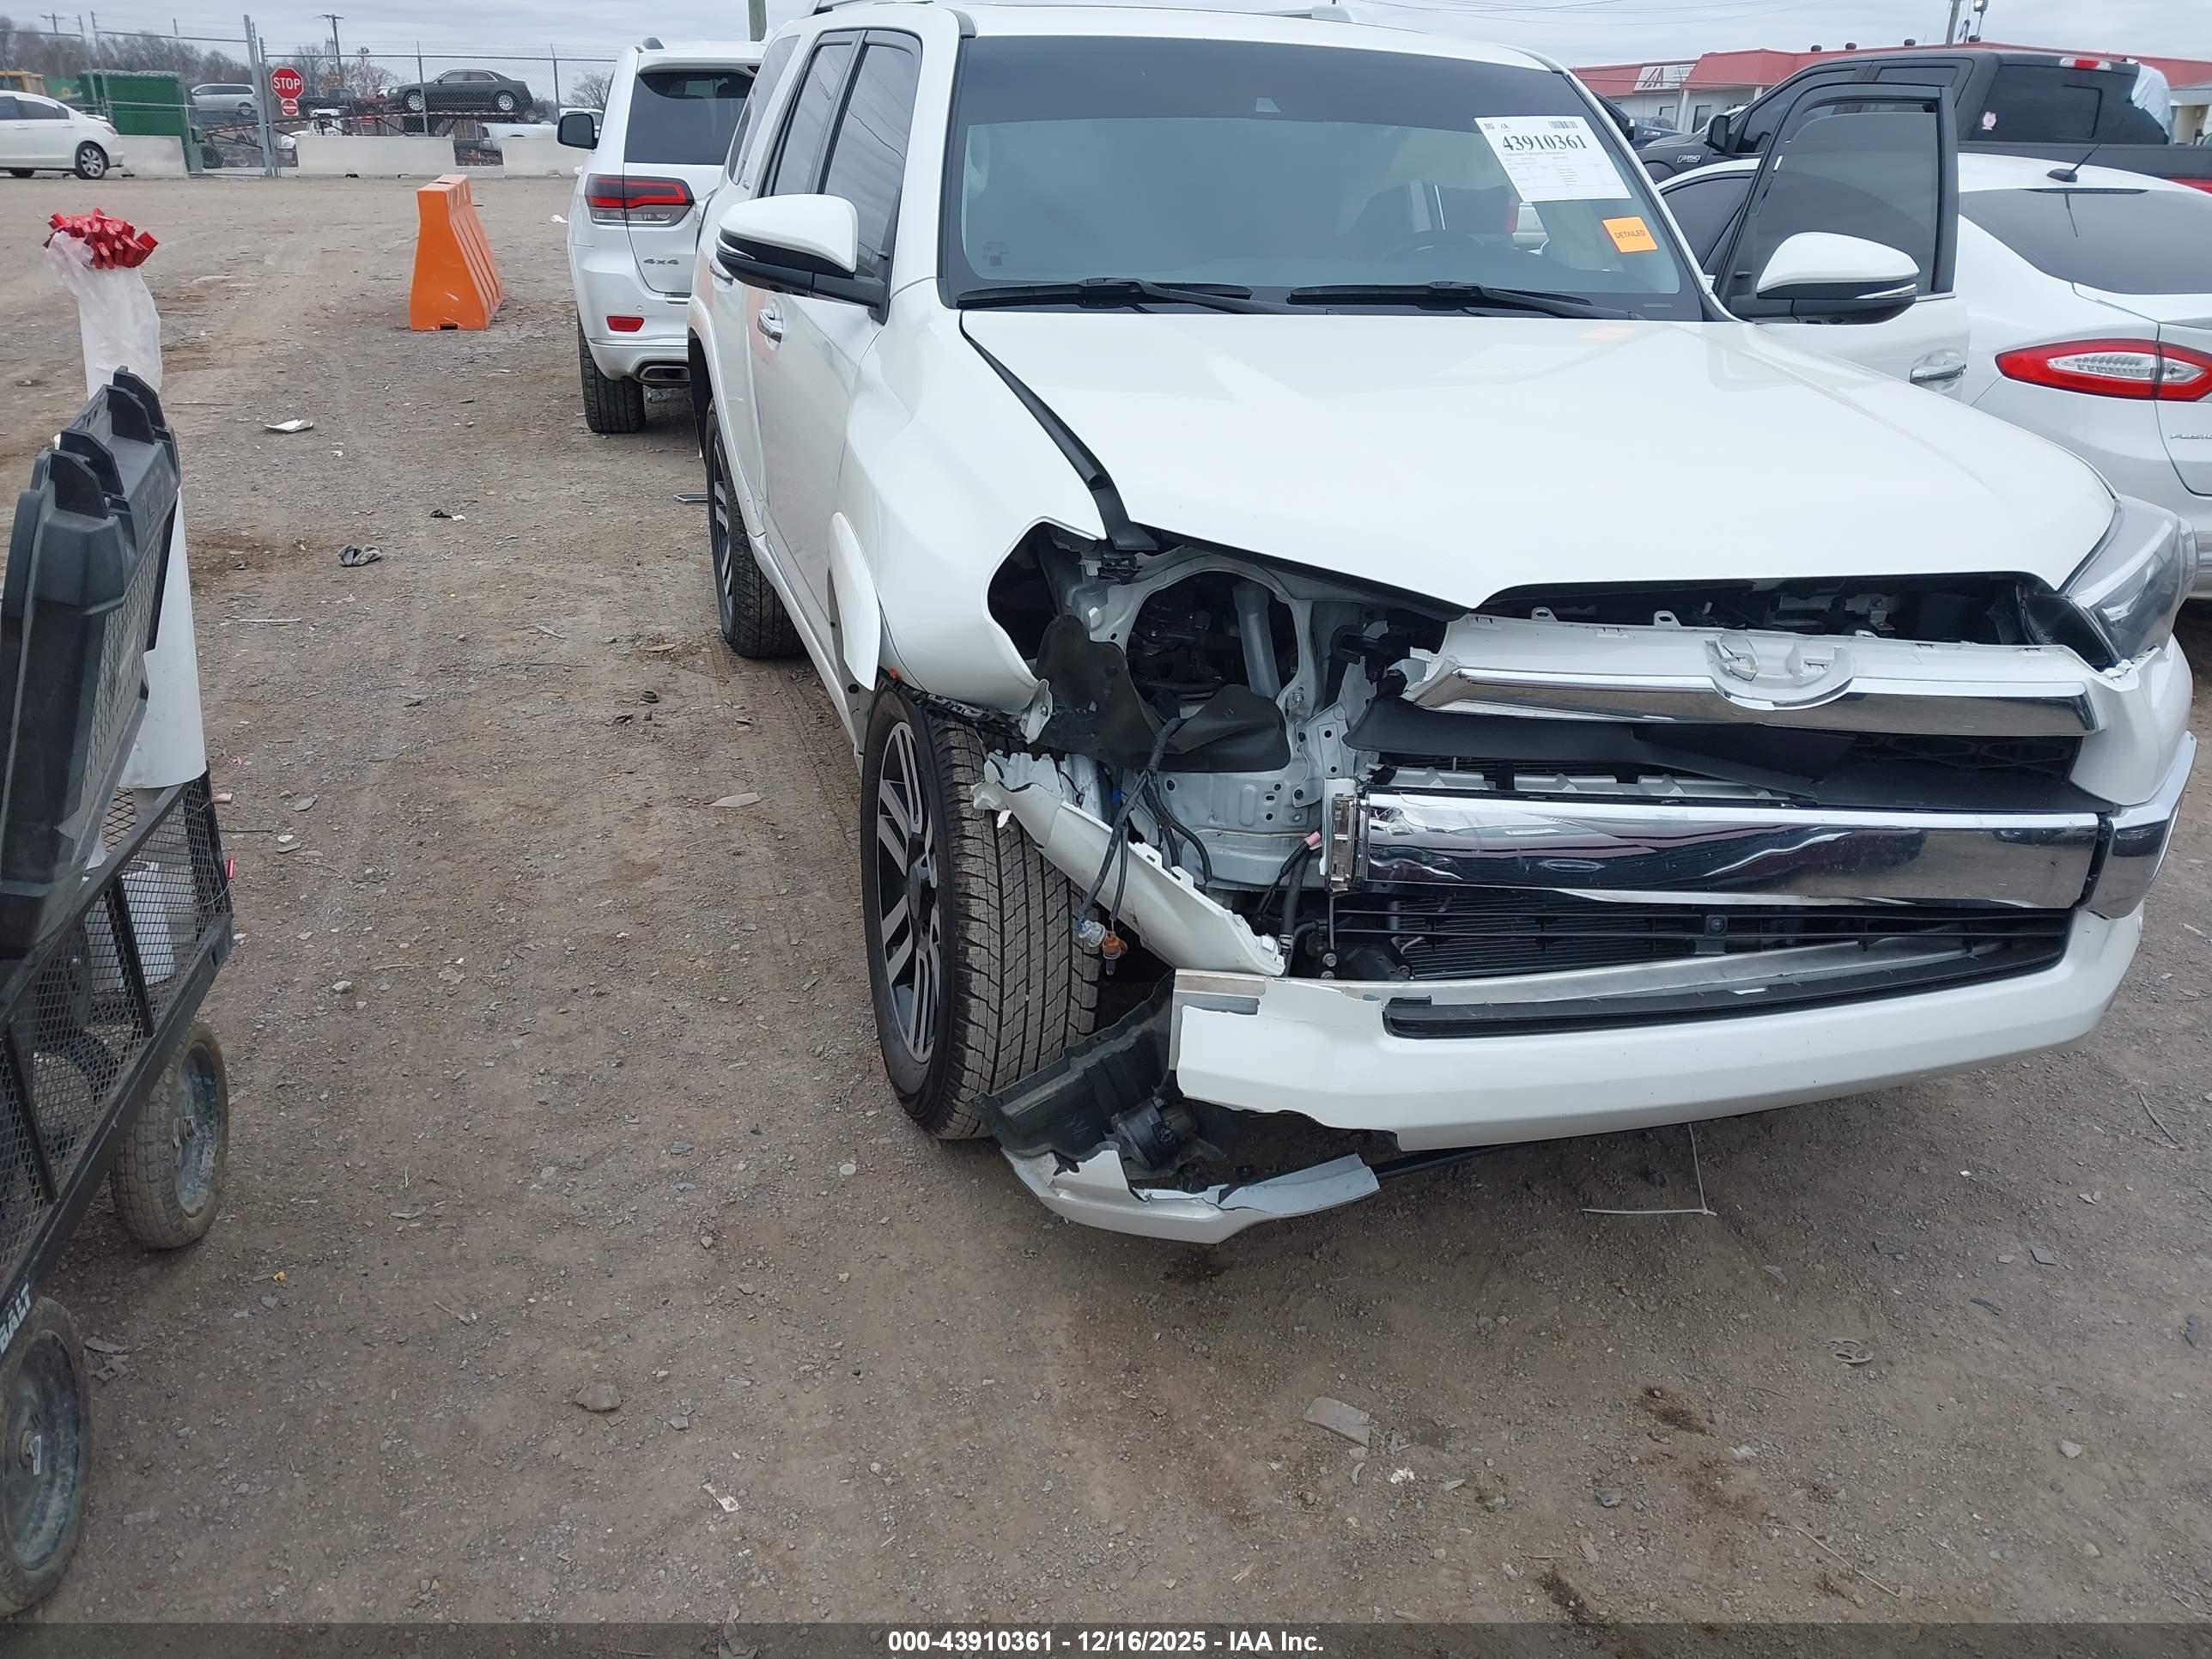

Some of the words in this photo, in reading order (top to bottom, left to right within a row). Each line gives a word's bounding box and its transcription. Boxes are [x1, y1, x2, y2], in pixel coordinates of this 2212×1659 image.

[273, 76, 301, 89] STOP
[1503, 134, 1587, 151] 43910361
[1614, 229, 1645, 239] DETAILED
